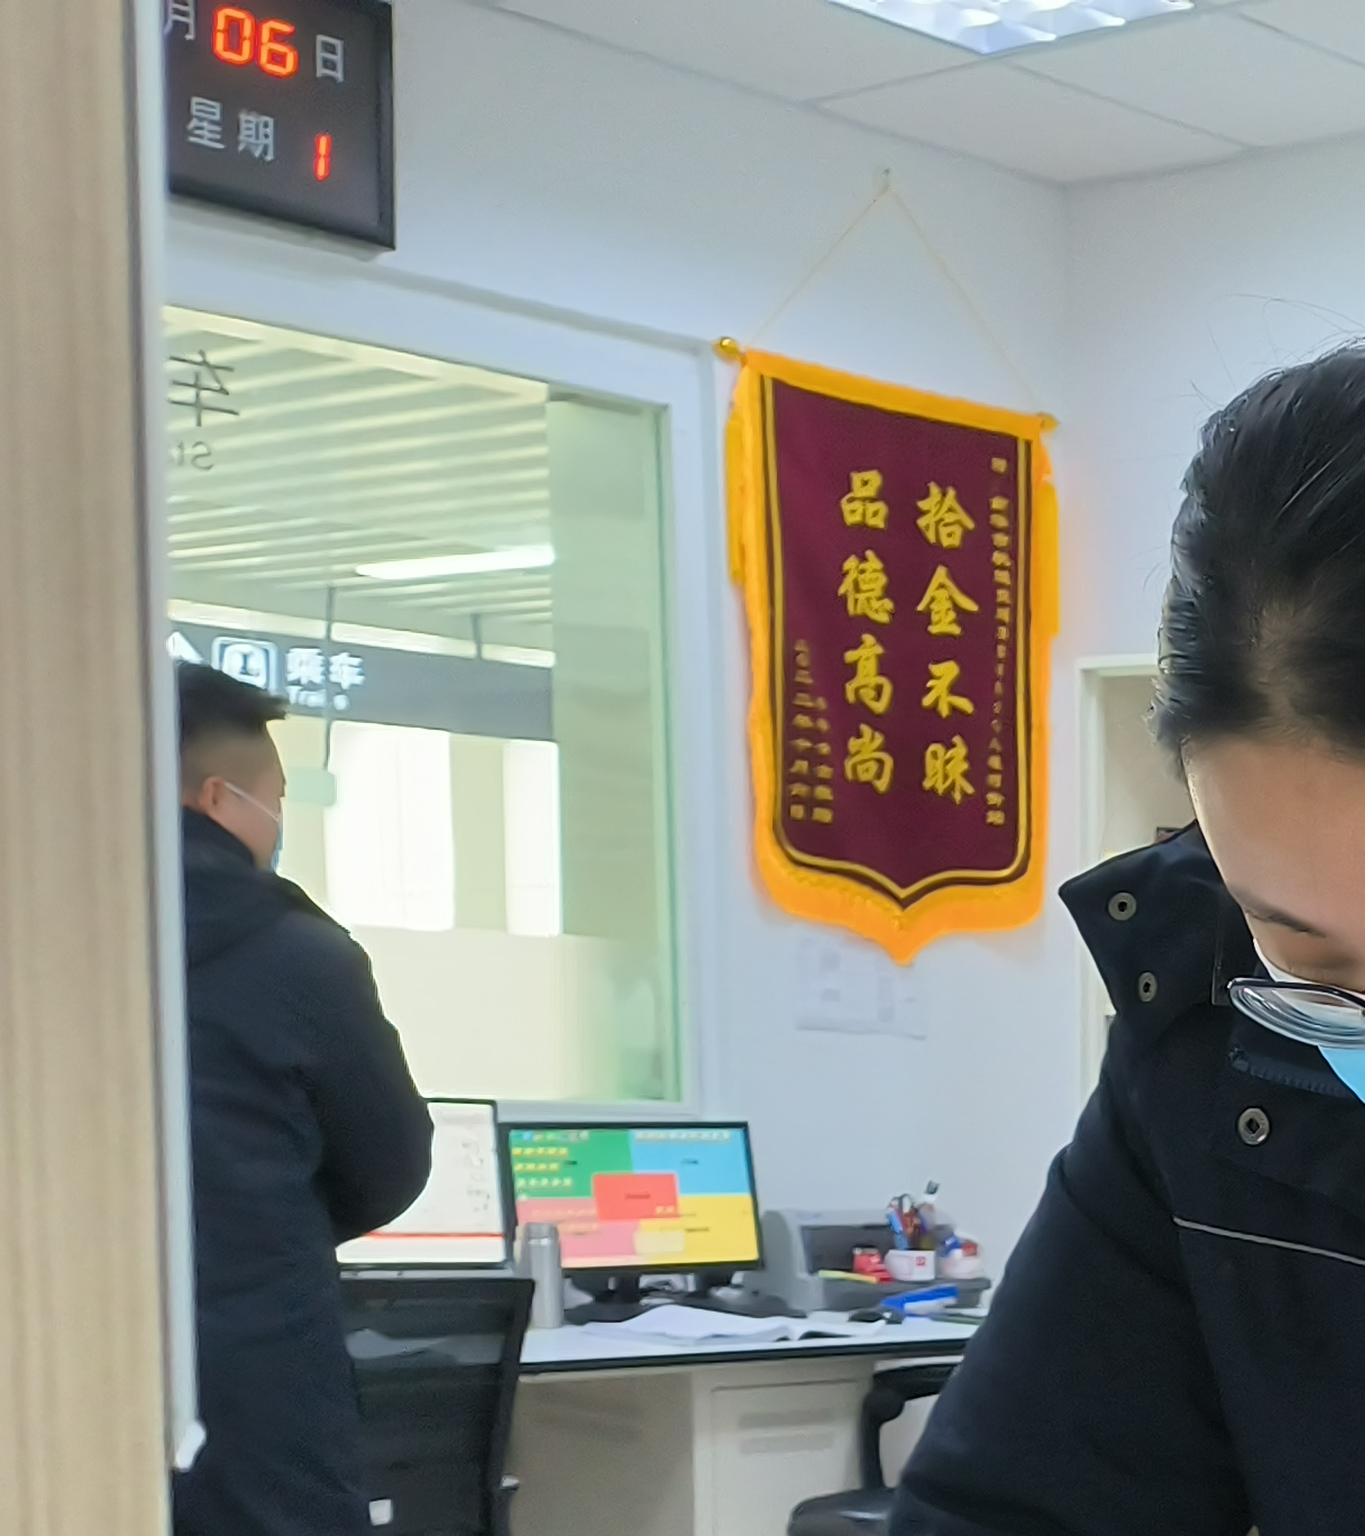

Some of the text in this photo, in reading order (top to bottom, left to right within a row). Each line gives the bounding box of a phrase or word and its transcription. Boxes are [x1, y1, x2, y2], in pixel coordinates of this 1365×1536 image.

[186, 96, 332, 182] 星期 1
[212, 5, 299, 79] 06
[315, 34, 346, 83] 日
[837, 468, 895, 795] 品德高尚
[915, 480, 979, 804] 拾金不昧
